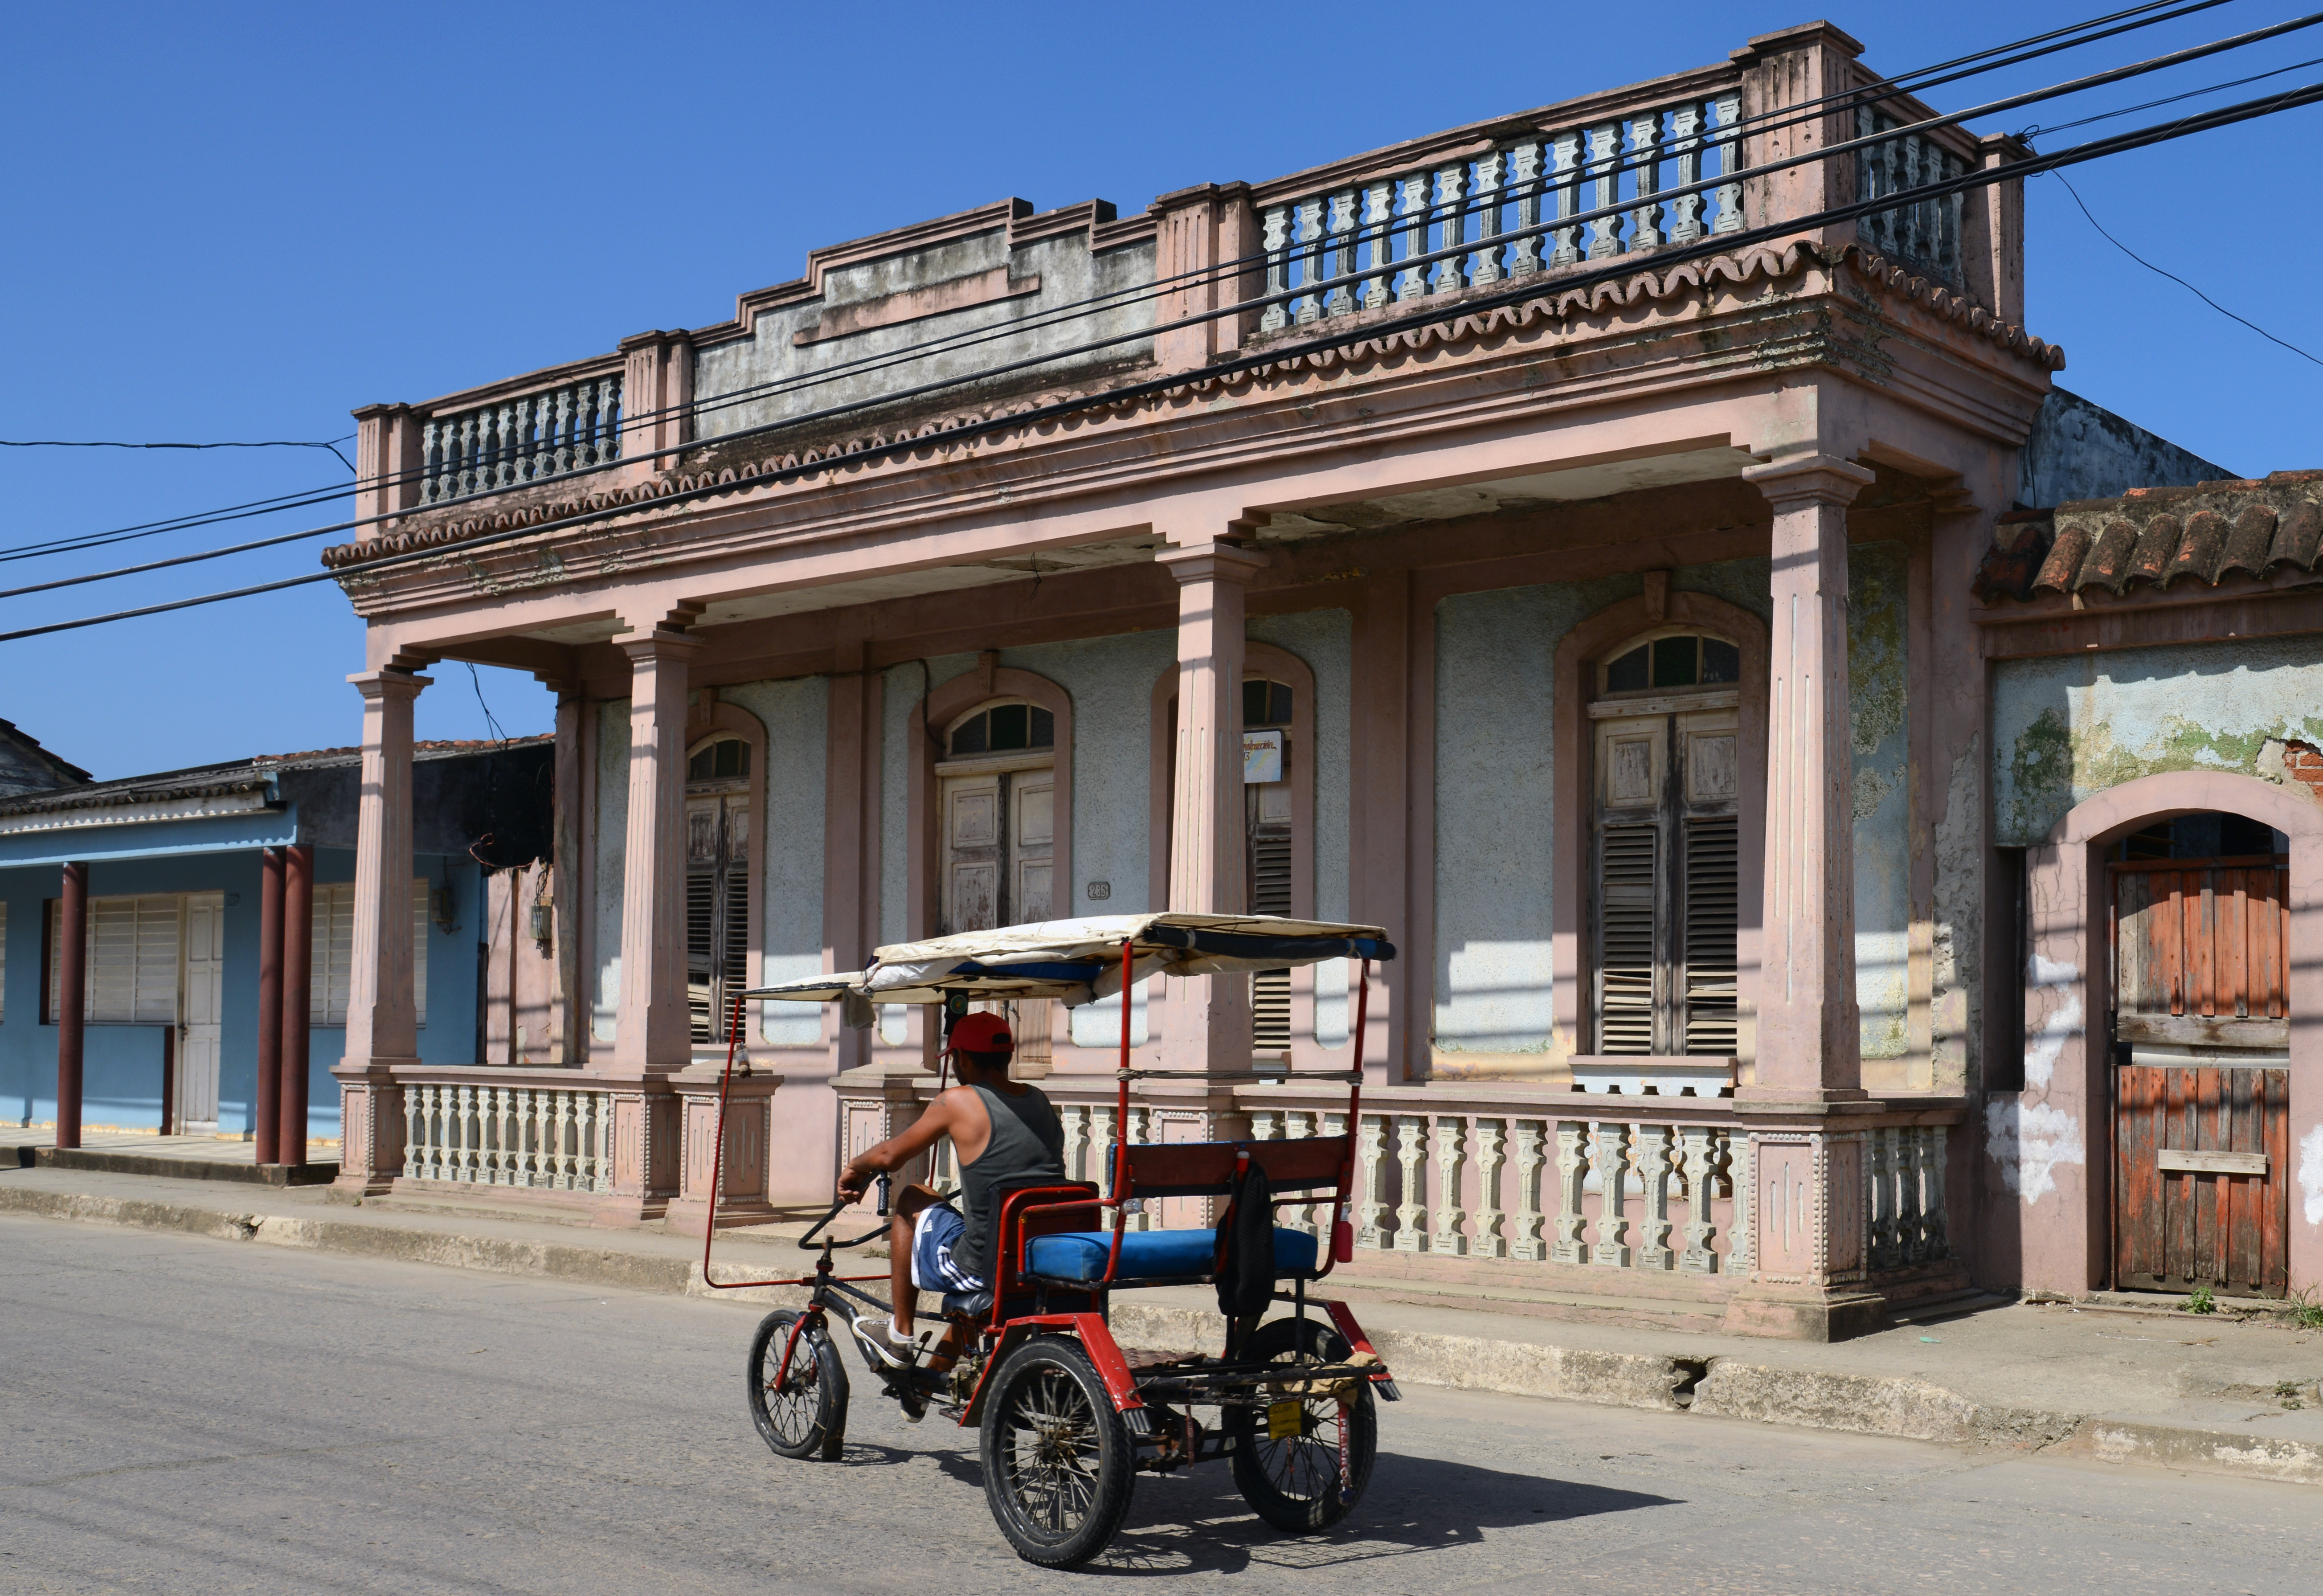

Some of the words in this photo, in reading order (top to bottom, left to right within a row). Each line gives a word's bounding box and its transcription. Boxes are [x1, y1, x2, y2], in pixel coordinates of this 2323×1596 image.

[1243, 739, 1277, 751] nstrucción
[1090, 884, 1106, 897] 285
[1340, 1418, 1349, 1478] PELIGRO
